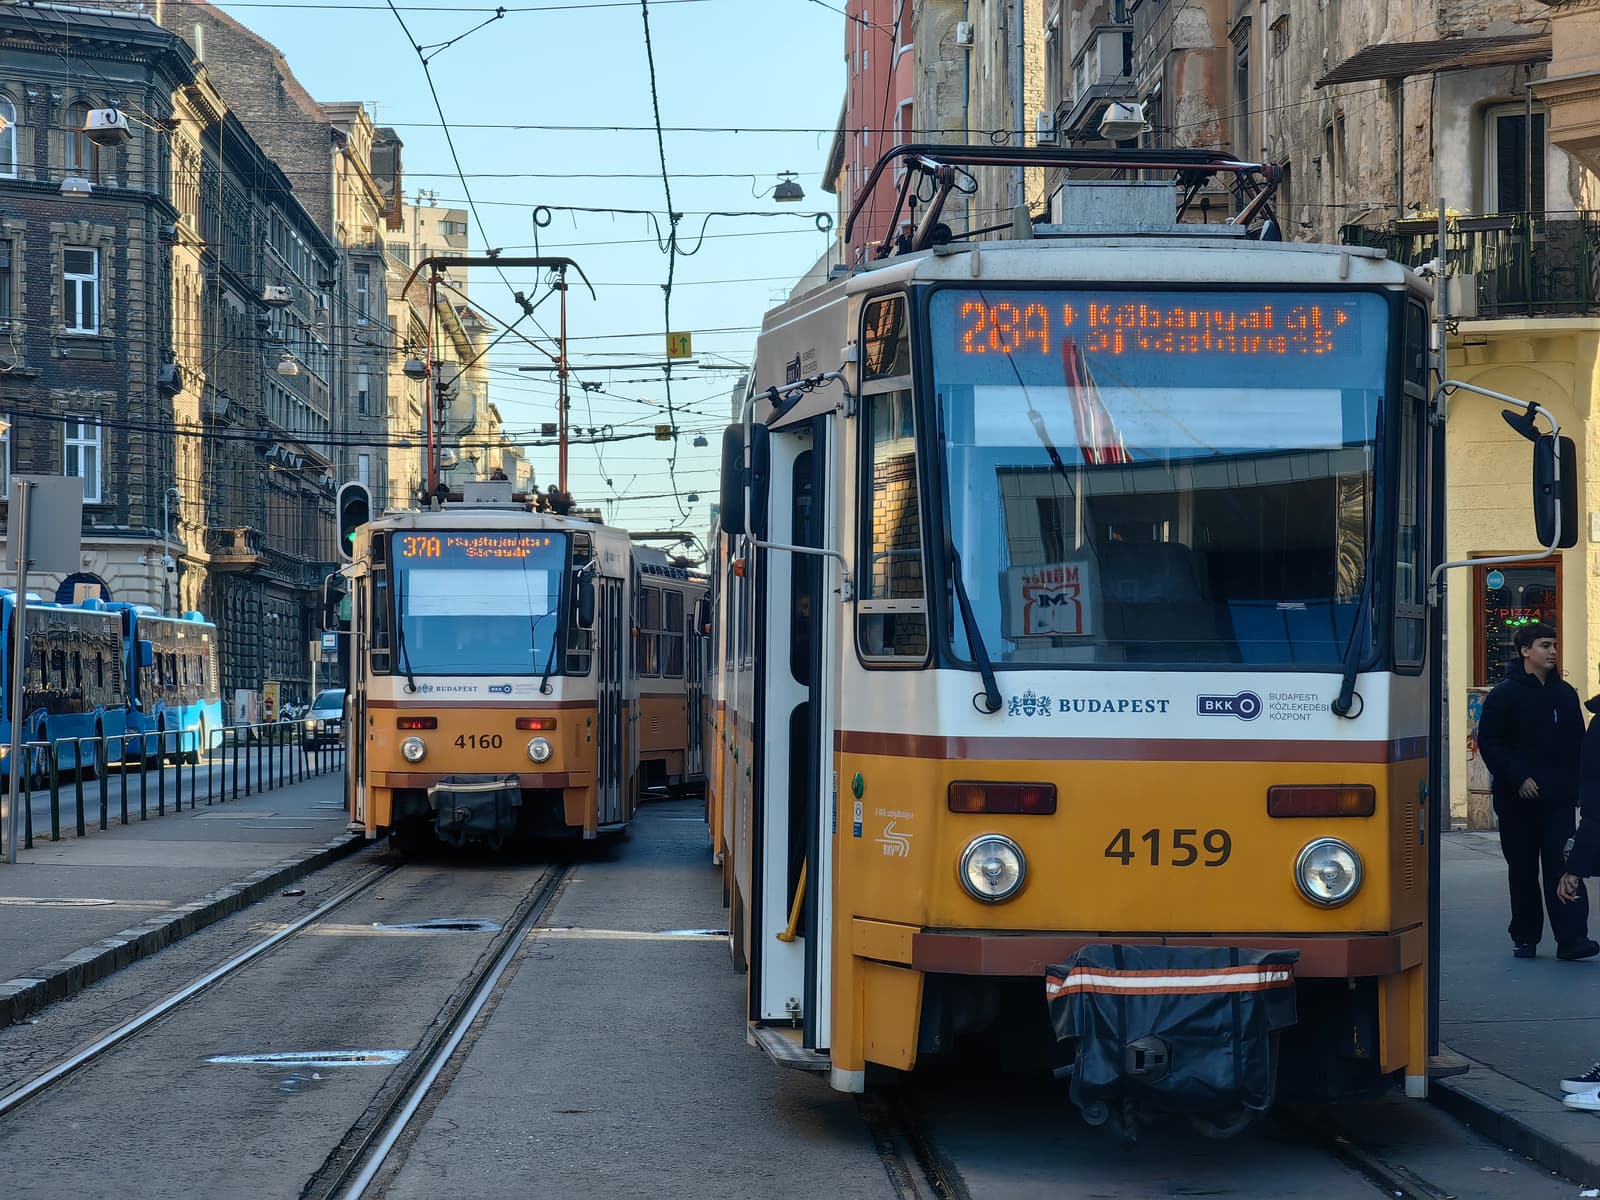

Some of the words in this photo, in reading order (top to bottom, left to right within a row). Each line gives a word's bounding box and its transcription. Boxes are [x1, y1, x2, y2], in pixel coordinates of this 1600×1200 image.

[960, 303, 1048, 353] 28A
[403, 536, 441, 557] 37A
[1500, 608, 1542, 618] PIZZA
[1269, 693, 1318, 701] BUDAPESTI
[1059, 699, 1170, 713] BUDAPEST
[1205, 700, 1233, 711] BKK
[1269, 702, 1329, 711] KÖZLEKEDÉSI
[454, 734, 503, 749] 4160
[1104, 828, 1232, 867] 4159
